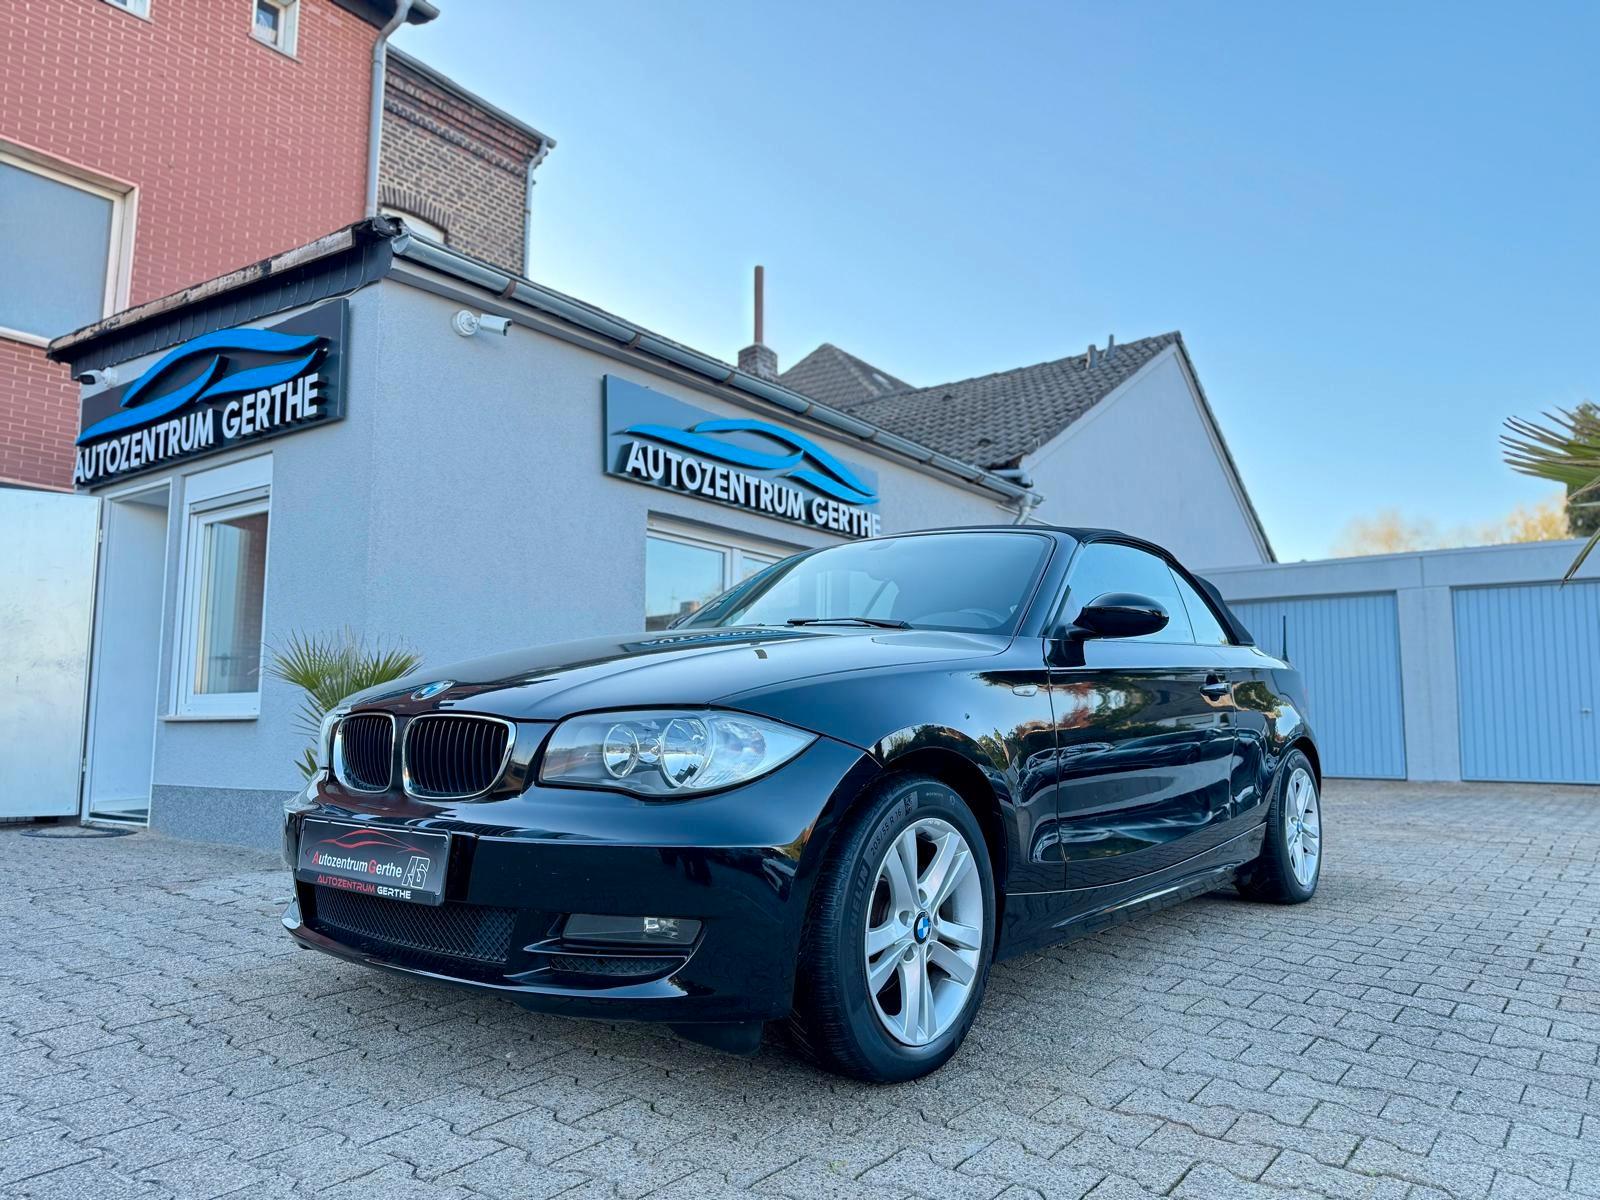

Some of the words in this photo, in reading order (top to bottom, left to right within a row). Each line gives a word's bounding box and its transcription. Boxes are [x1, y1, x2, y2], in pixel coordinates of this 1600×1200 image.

[72, 408, 213, 484] AUTOZENTRUM
[221, 373, 319, 439] GERTHE
[625, 441, 805, 520] AUTOZENTRUM
[811, 497, 881, 538] GERTHE
[317, 874, 376, 893] AUTOZENTRUM
[376, 886, 412, 900] GERTHE
